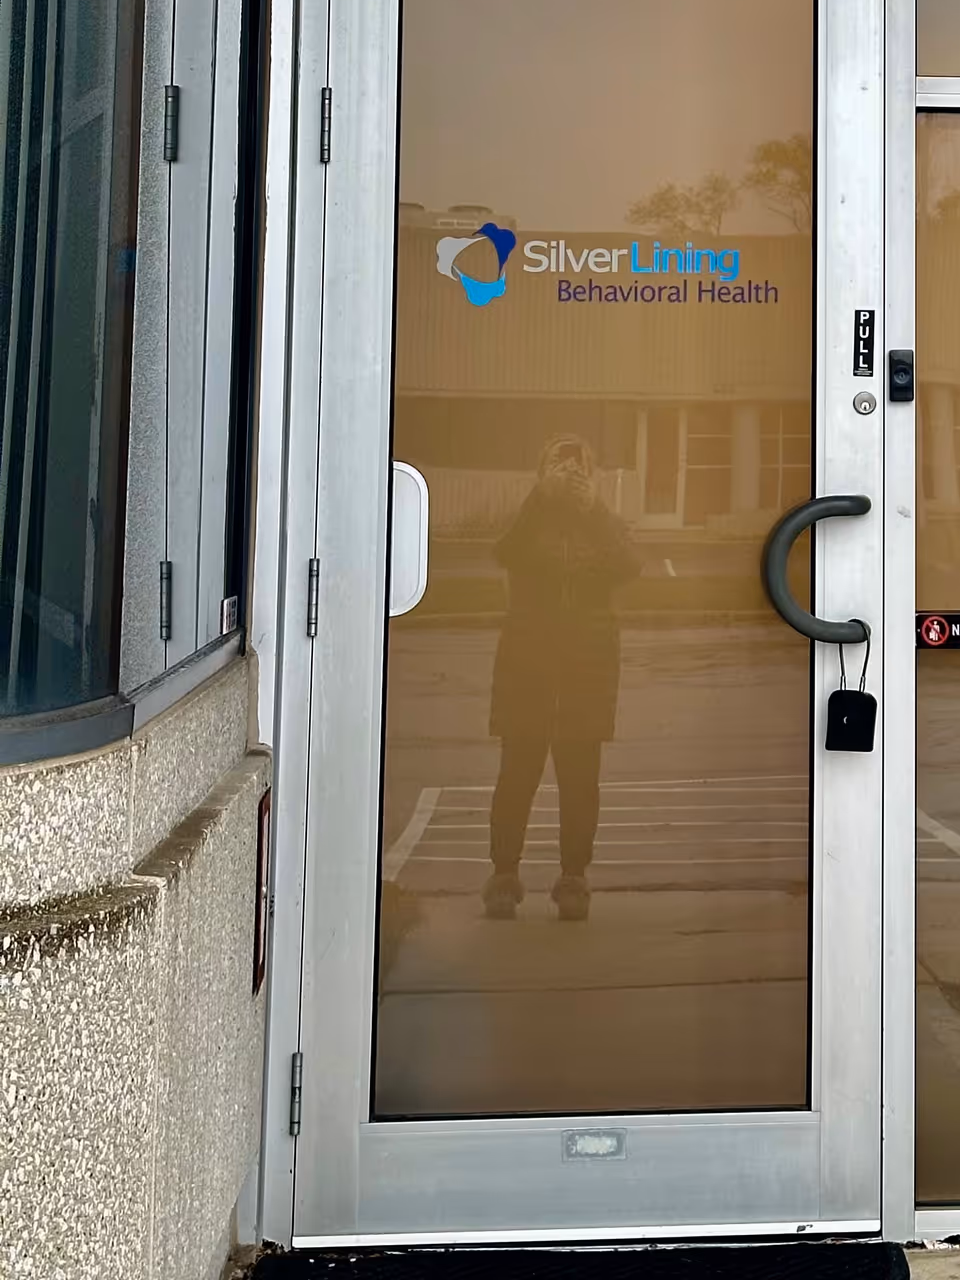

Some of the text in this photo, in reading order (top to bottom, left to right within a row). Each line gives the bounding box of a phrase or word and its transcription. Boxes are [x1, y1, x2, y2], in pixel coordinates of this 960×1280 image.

[523, 240, 740, 280] SilverLining
[557, 280, 779, 304] Behavioral Health
[859, 311, 870, 368] PULL
